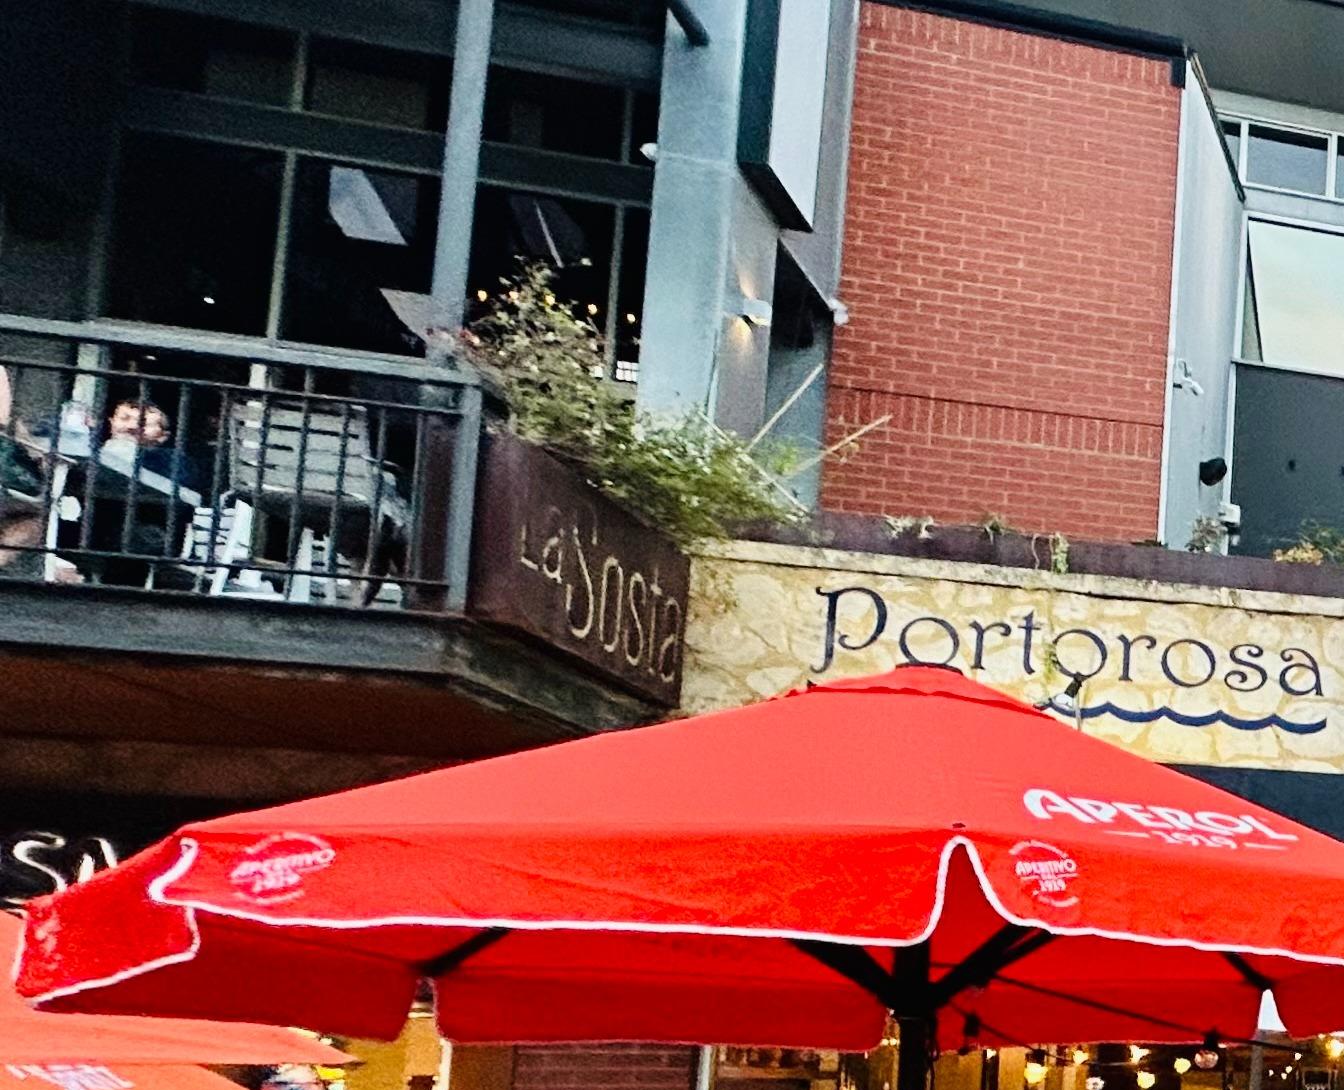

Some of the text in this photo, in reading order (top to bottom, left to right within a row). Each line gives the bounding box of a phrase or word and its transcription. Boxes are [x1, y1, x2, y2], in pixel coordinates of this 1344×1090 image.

[564, 508, 682, 683] Sosta
[809, 585, 1325, 697] Portorosa
[1022, 787, 1300, 842] APEROL
